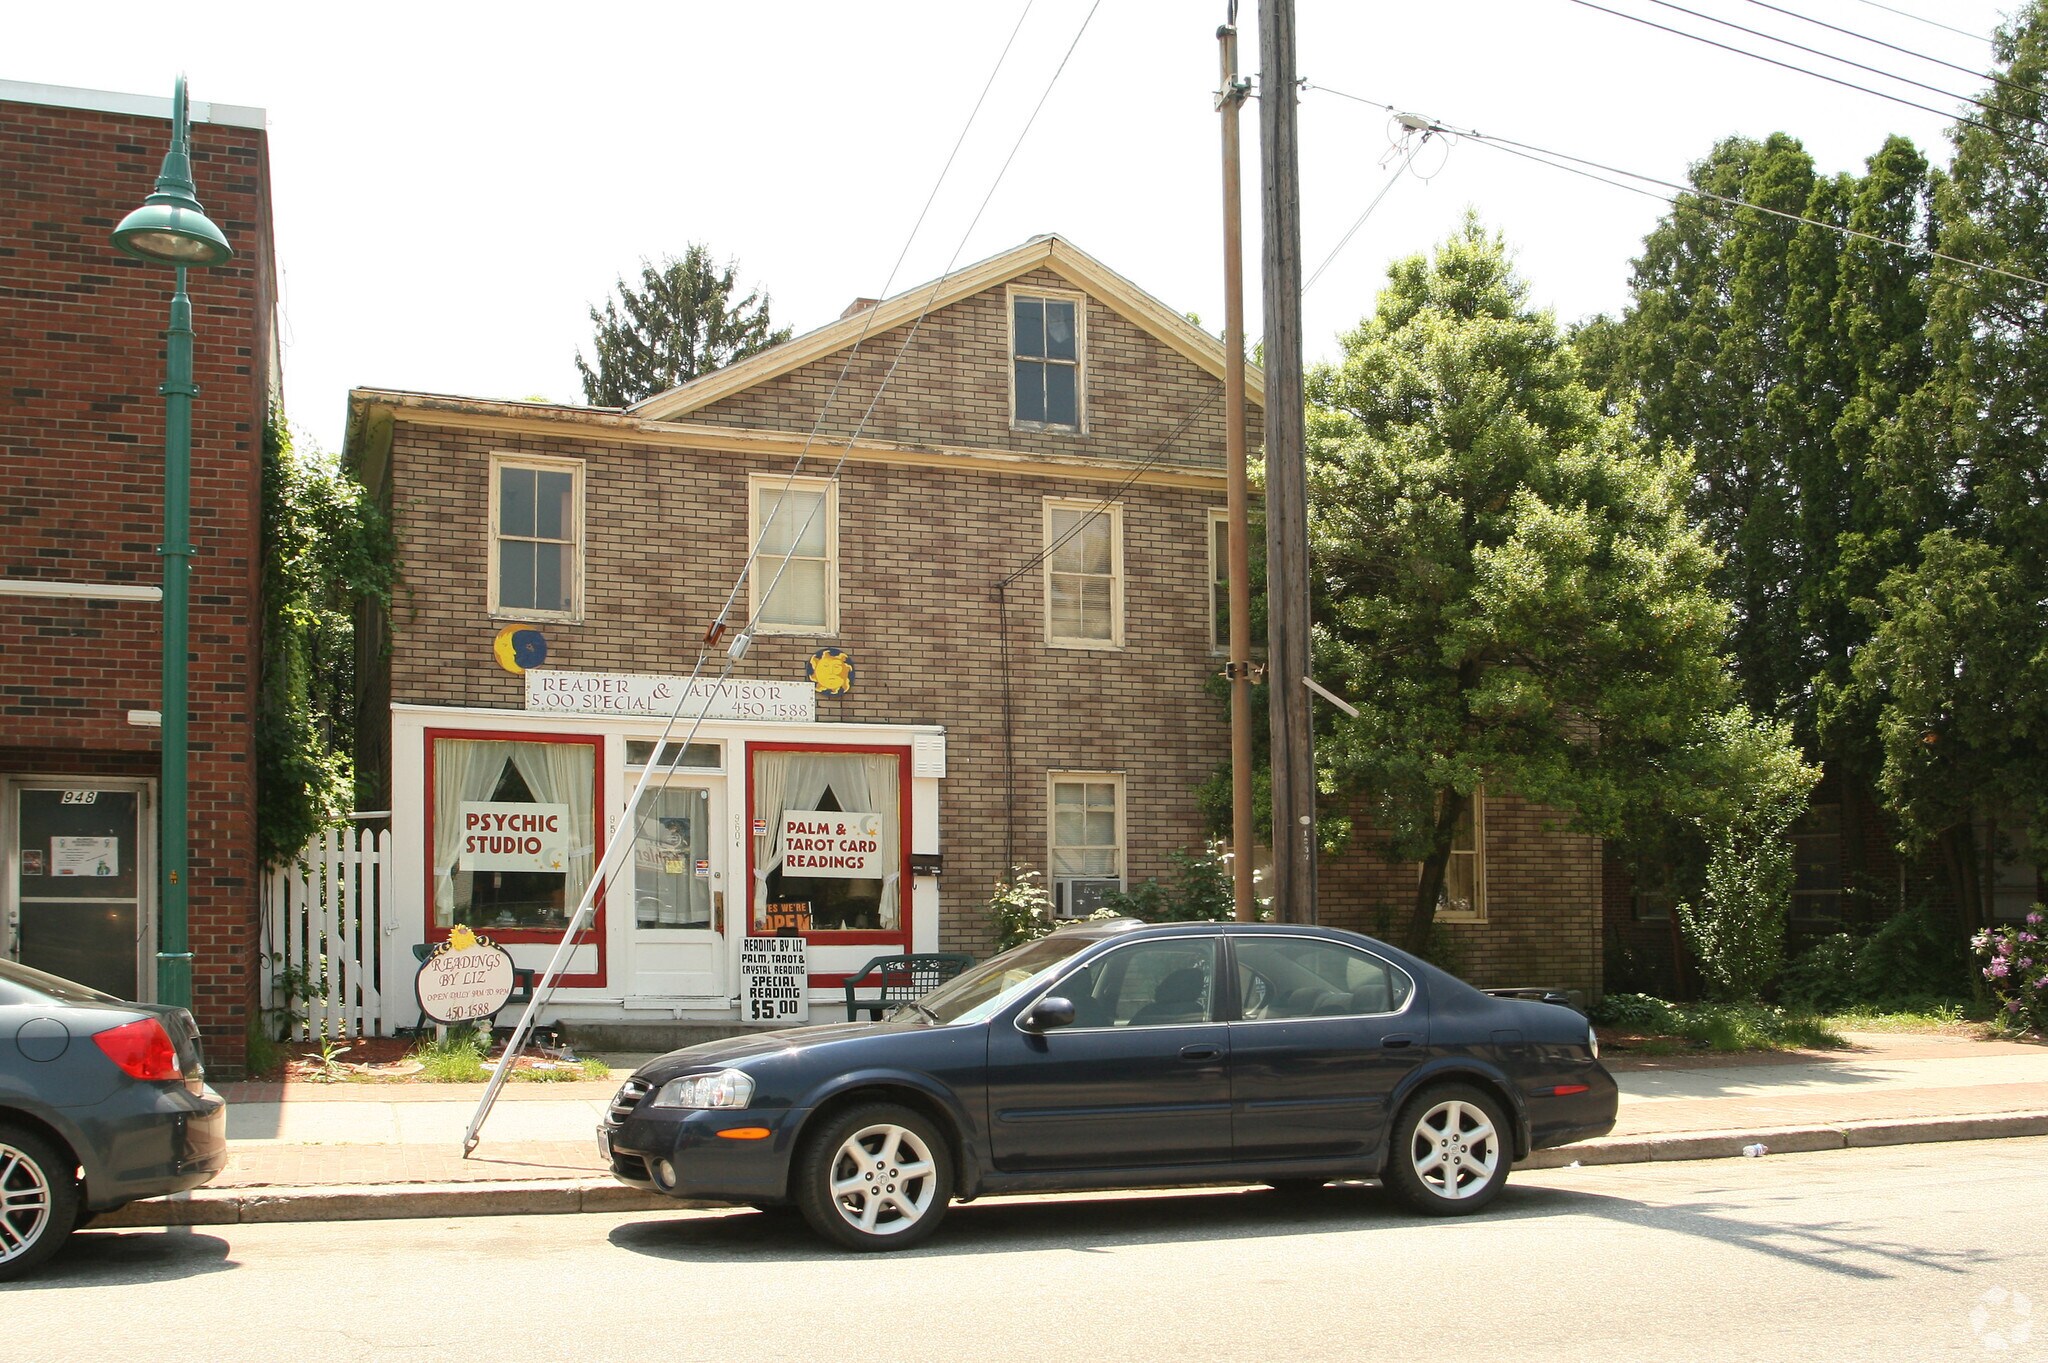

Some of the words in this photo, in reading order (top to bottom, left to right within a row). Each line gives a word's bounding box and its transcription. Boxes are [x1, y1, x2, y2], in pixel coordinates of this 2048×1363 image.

[543, 678, 628, 693] READER
[652, 683, 672, 699] &
[689, 684, 782, 700] ADVISOR
[532, 693, 574, 708] 5.00
[582, 694, 657, 711] SPECIAL
[731, 702, 808, 717] 450-1588
[63, 791, 96, 804] 948
[466, 813, 558, 833] PSYCHIC
[787, 821, 830, 835] PALM
[836, 823, 847, 836] &
[466, 835, 542, 855] STUDIO
[786, 838, 835, 851] TAROT
[840, 840, 877, 852] CARD
[786, 854, 865, 869] READINGS
[781, 902, 807, 912] WE'RE
[744, 939, 776, 952] READING
[780, 939, 789, 952] BY
[793, 939, 803, 952] LIZ
[431, 953, 501, 972] READINGS
[741, 954, 770, 964] PALM,
[742, 965, 771, 975] CRYSTAL
[774, 965, 805, 975] READING
[439, 972, 459, 987] BY
[463, 970, 486, 985] LIZ
[752, 976, 796, 987] SPECIAL
[427, 991, 449, 1001] OPEN
[749, 987, 800, 998] READING
[445, 1002, 490, 1019] 450-1588
[751, 998, 798, 1020] $5.00
